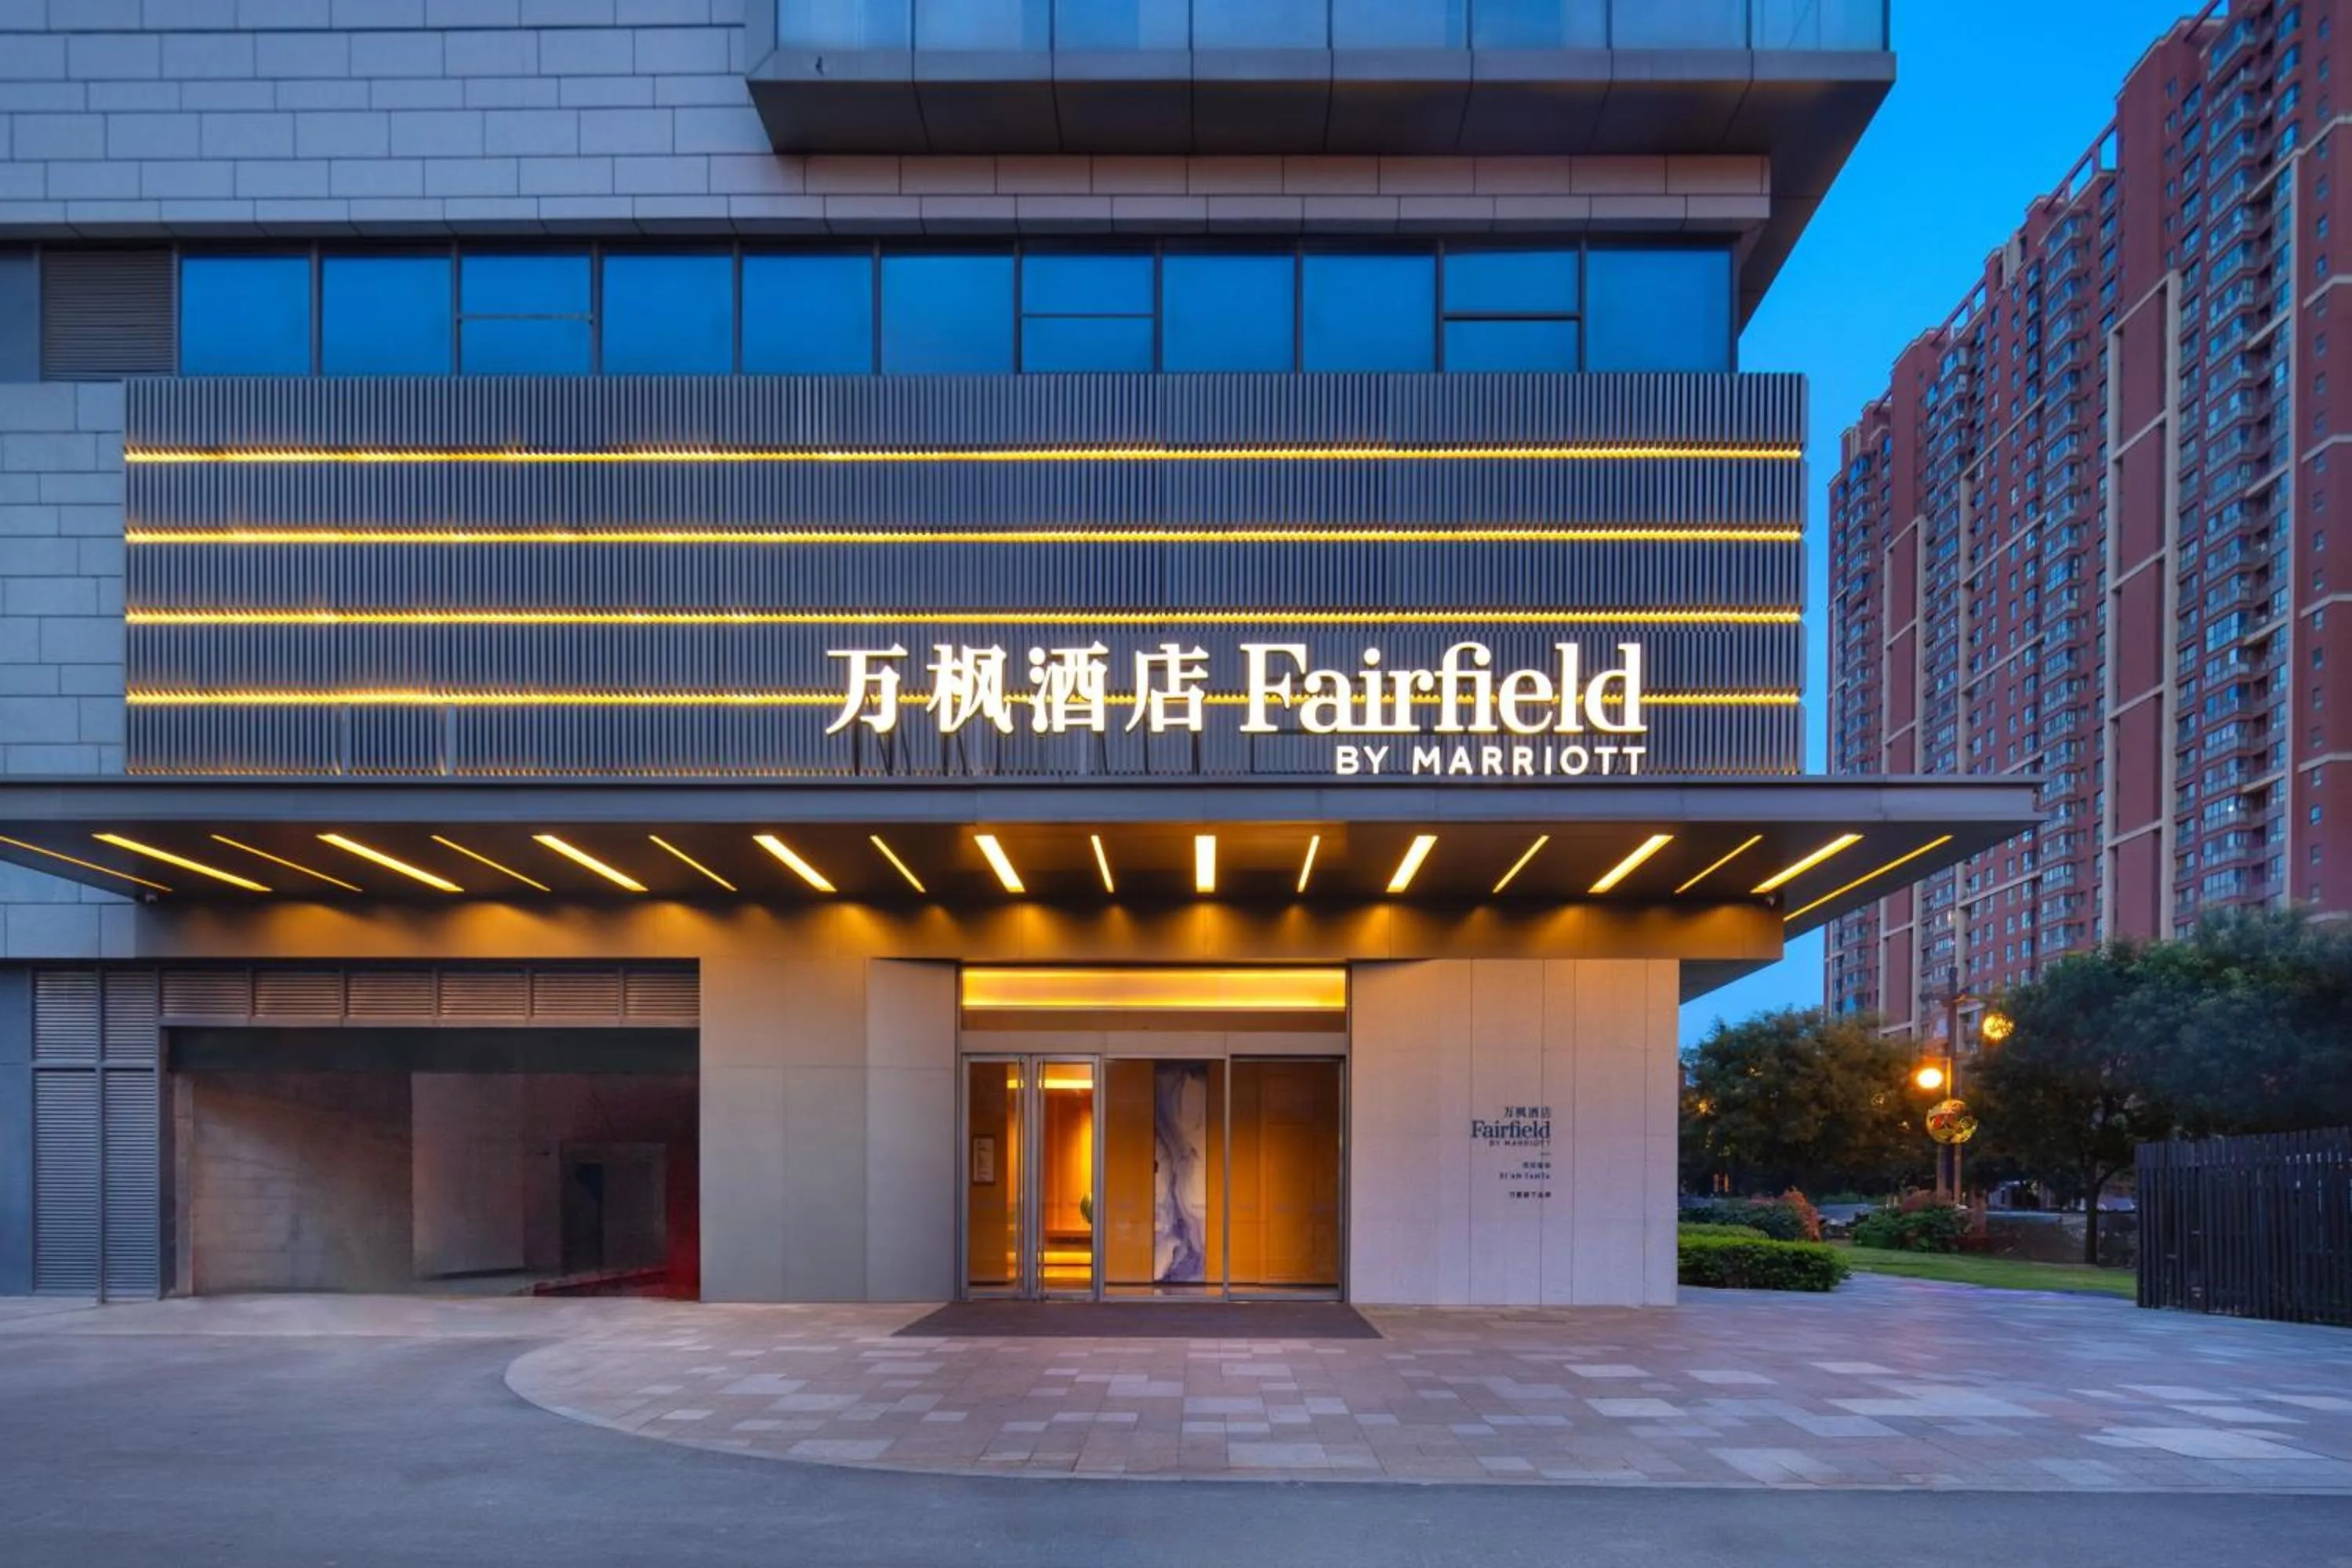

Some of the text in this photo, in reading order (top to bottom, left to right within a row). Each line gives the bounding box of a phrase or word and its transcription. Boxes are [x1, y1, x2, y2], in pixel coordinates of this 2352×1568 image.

[825, 641, 1210, 735] 万枫酒店
[1239, 641, 1648, 734] Fairfield
[1335, 745, 1646, 776] BY MARRIOTT
[1472, 1120, 1550, 1138] Fairfield
